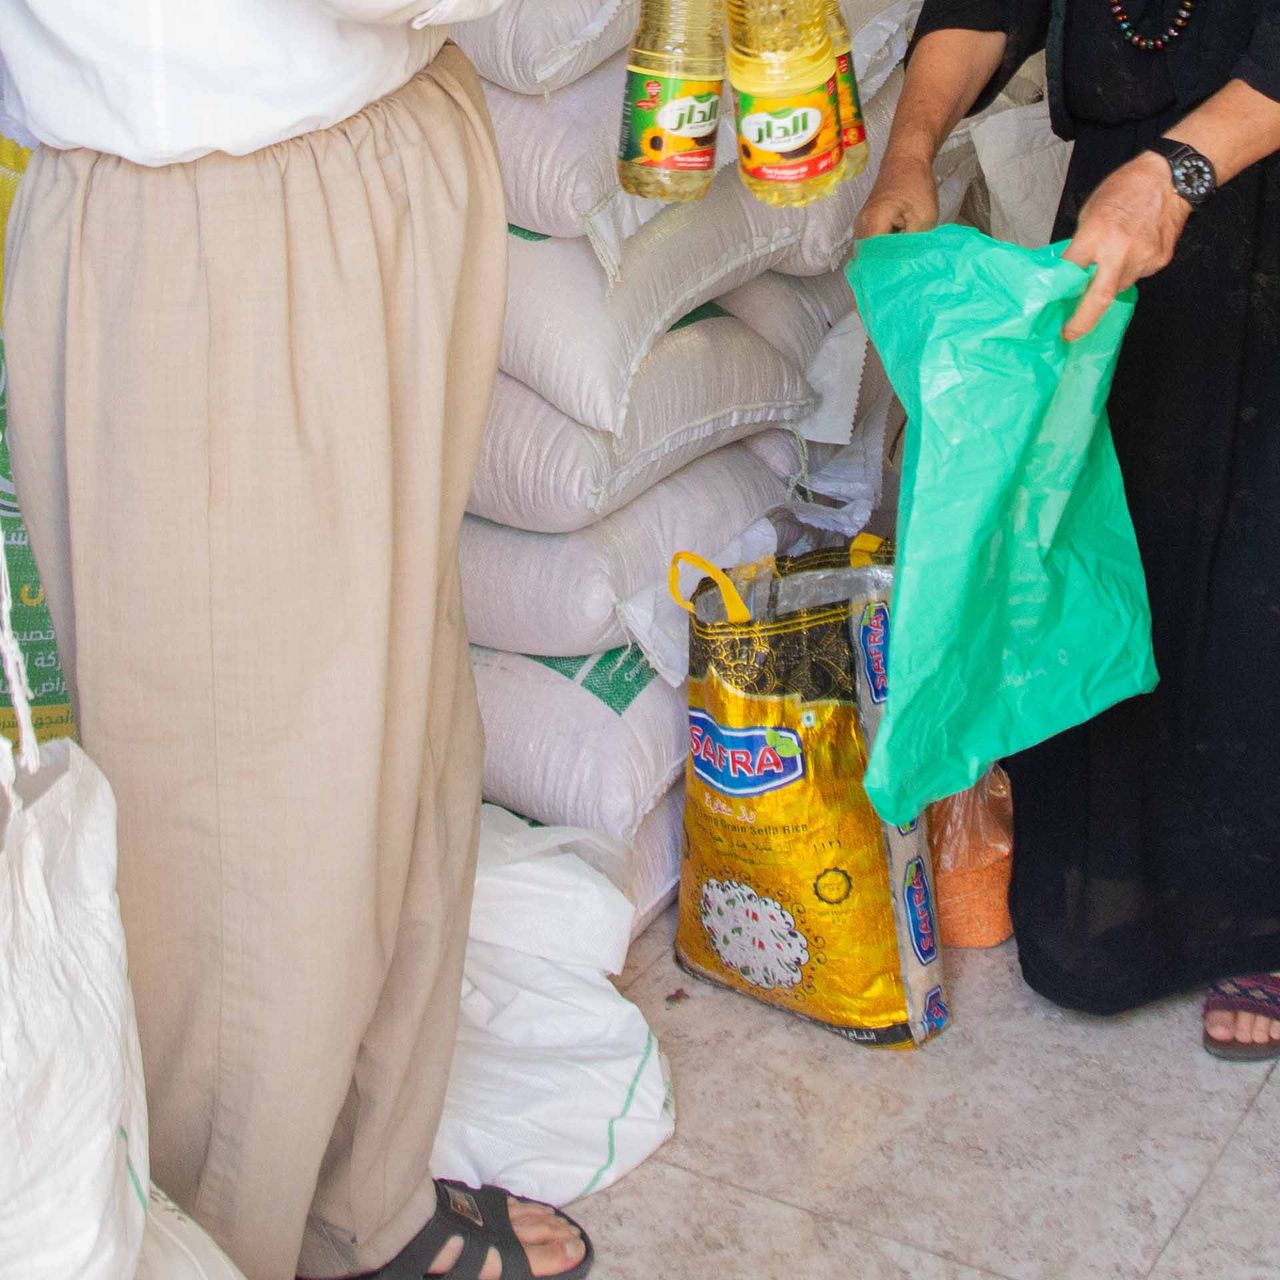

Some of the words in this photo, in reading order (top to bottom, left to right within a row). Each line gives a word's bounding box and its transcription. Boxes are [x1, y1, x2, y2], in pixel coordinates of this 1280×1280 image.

[752, 111, 809, 144] الدار
[872, 612, 889, 695] SAFRA
[688, 726, 784, 778] SAFRA
[782, 822, 808, 835] Rice
[913, 871, 935, 952] SAFRA
